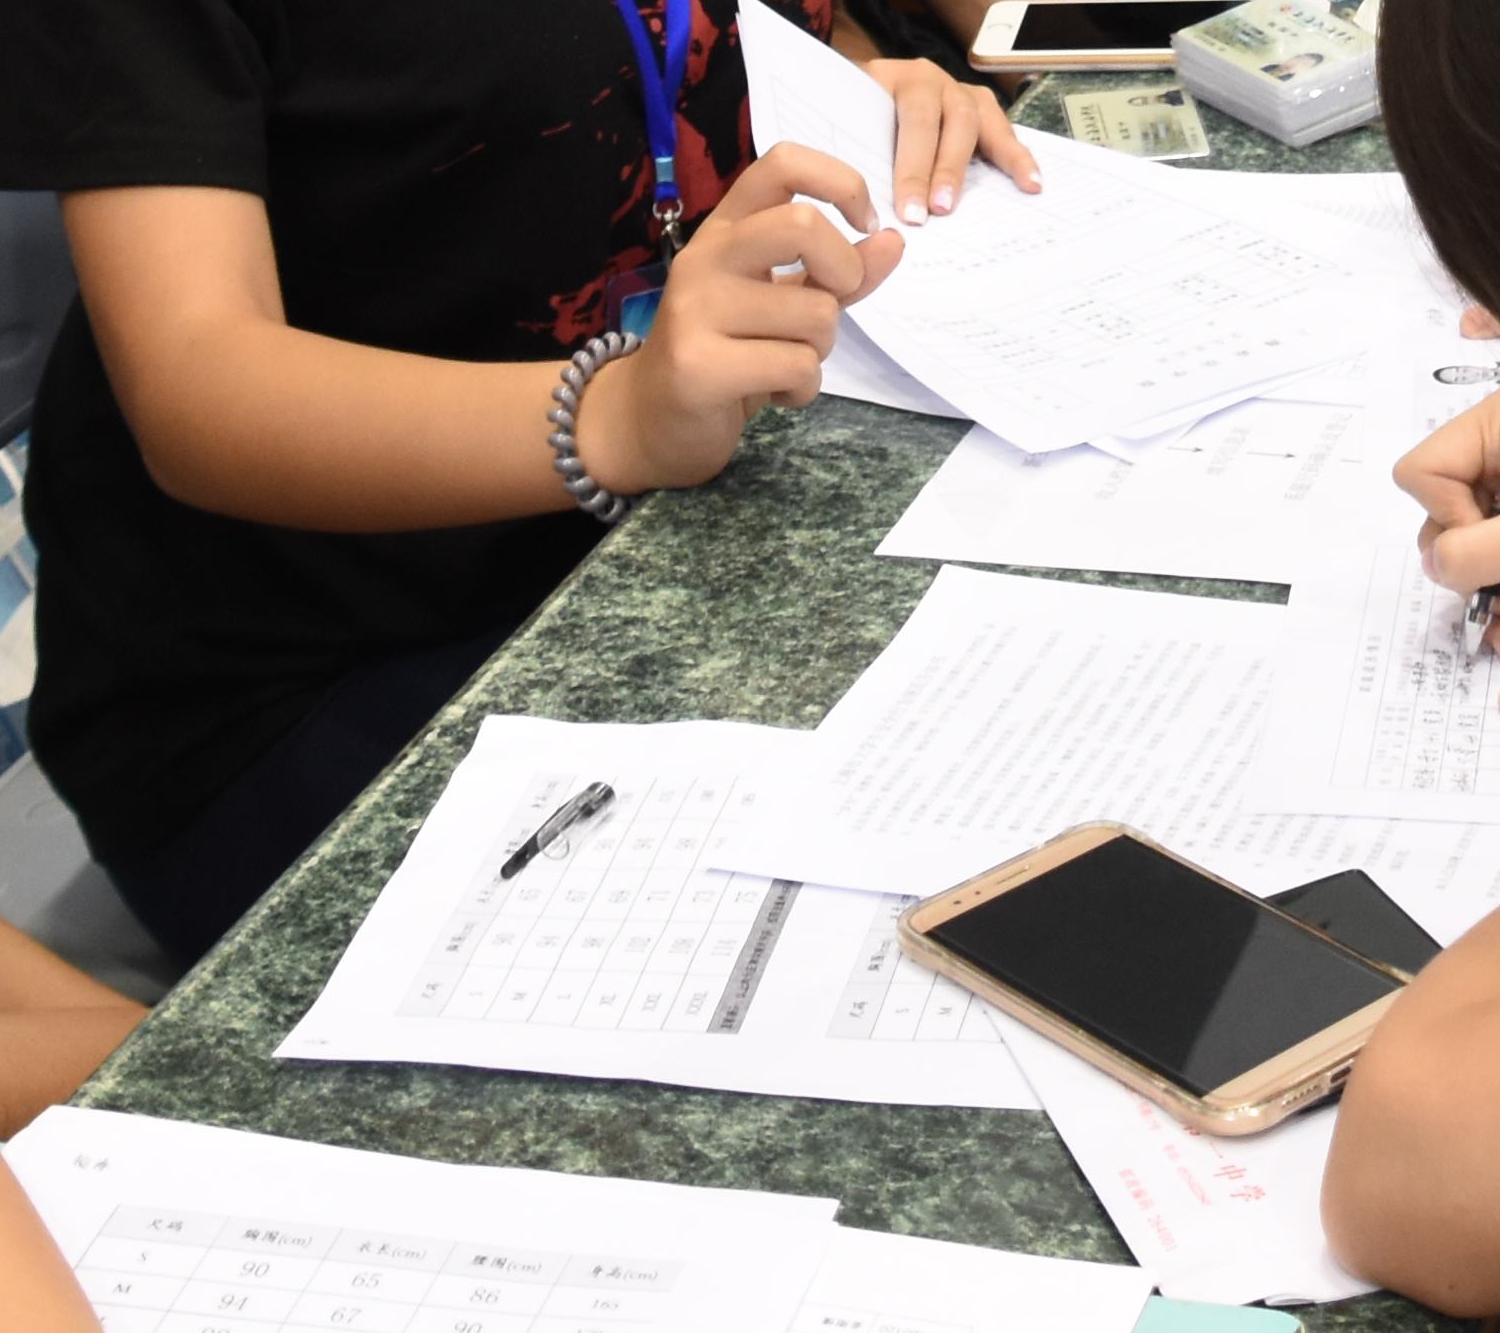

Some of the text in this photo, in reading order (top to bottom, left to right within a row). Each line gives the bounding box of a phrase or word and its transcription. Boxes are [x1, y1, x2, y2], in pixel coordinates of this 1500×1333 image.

[238, 1260, 271, 1279] 90
[112, 1282, 133, 1295] M
[350, 1271, 381, 1290] 65
[216, 1292, 251, 1312] 94
[469, 1286, 500, 1305] 86
[329, 1307, 362, 1325] 67
